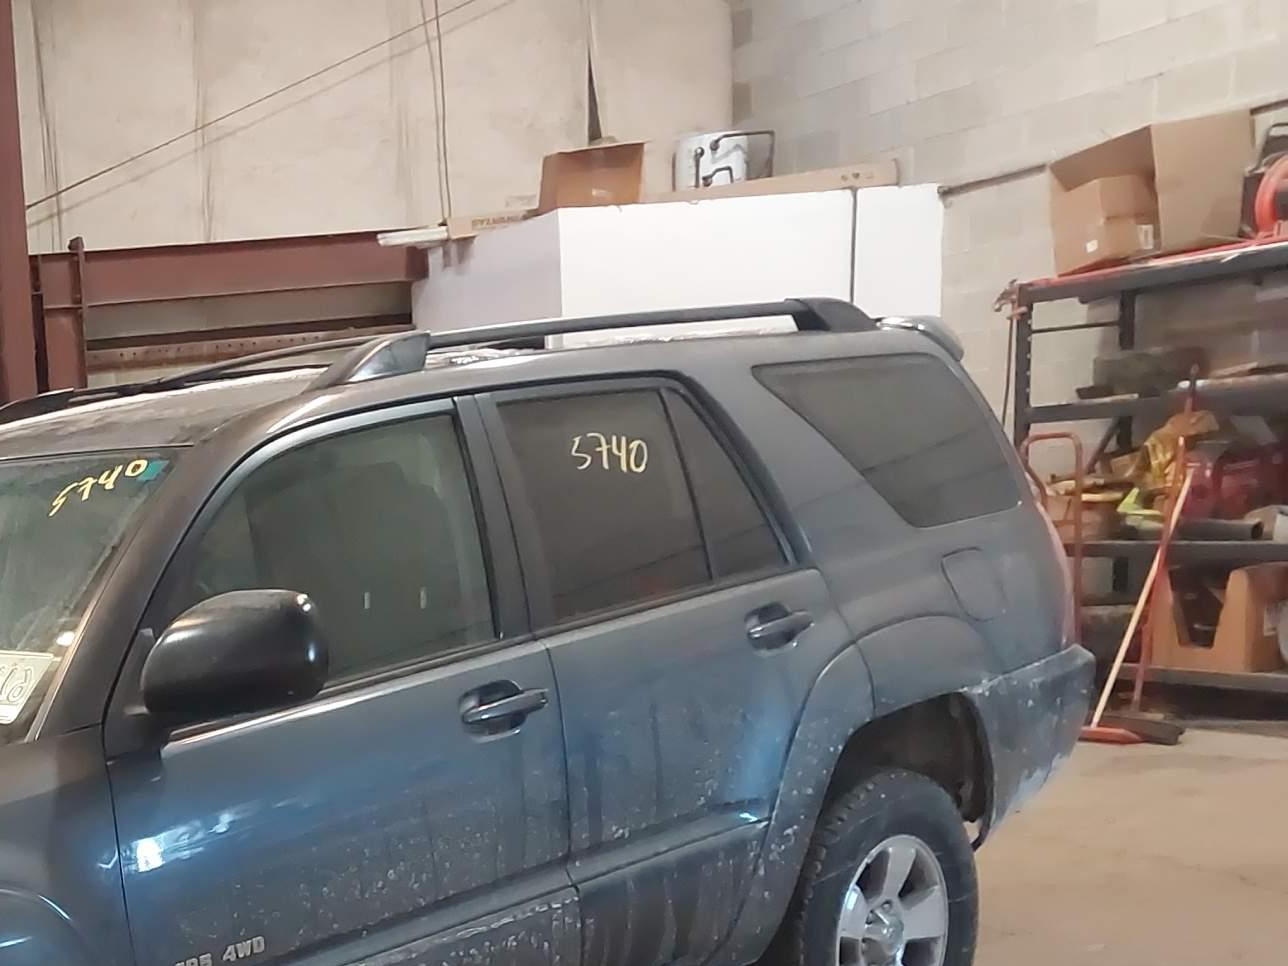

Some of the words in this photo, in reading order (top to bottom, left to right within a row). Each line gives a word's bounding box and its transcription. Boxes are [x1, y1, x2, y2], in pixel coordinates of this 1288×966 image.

[571, 432, 648, 473] 5740
[48, 459, 148, 517] 5740
[222, 936, 265, 962] 4WD
